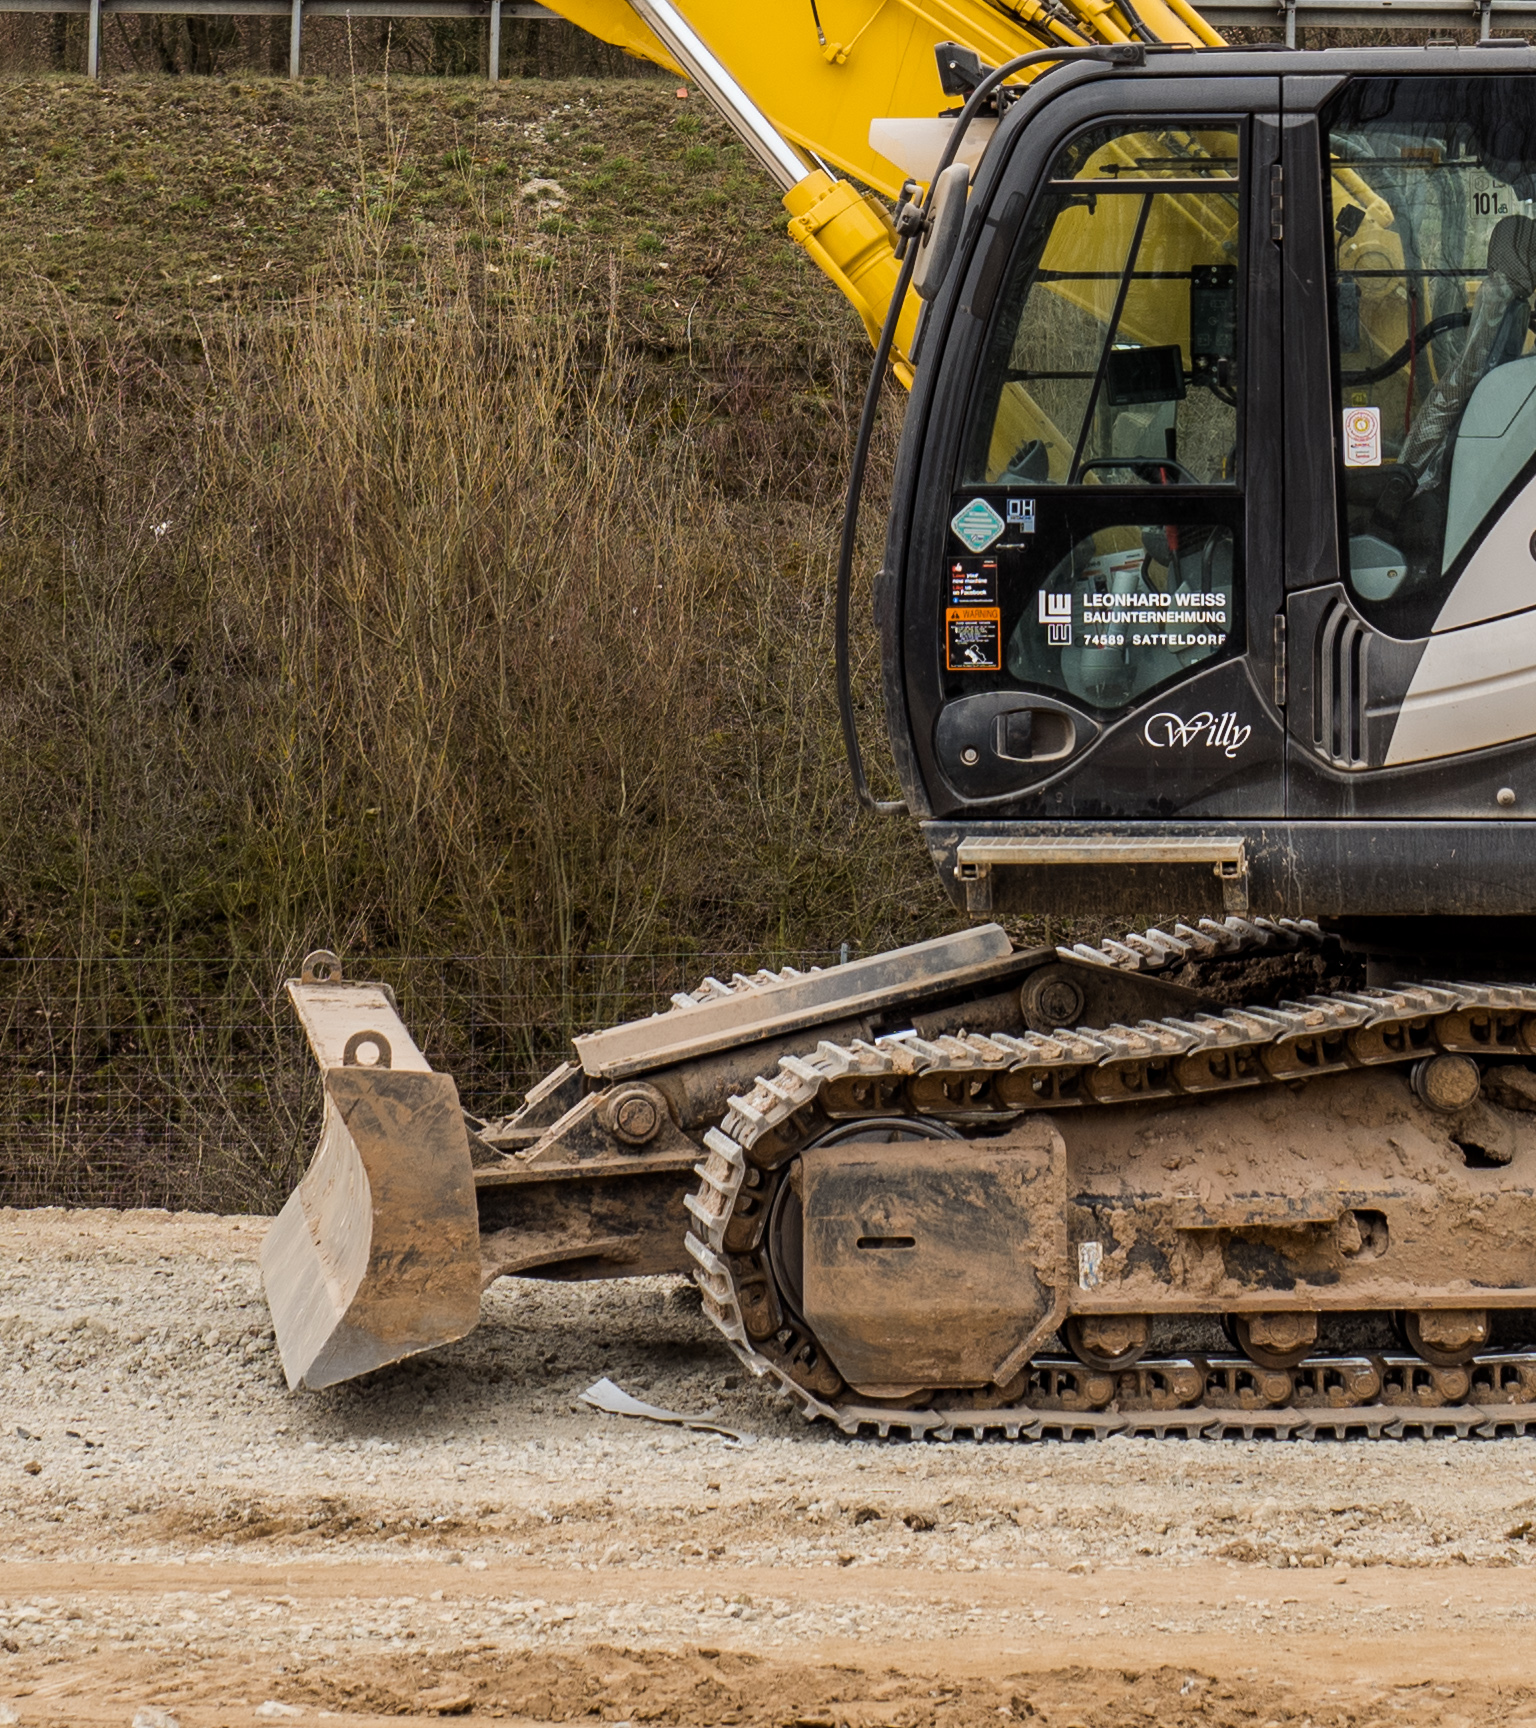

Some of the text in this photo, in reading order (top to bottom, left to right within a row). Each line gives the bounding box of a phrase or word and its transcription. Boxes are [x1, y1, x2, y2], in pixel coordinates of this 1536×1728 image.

[1472, 192, 1498, 216] 101
[1083, 592, 1227, 607] LEONHARD WEISS
[963, 609, 999, 619] WARNING
[1083, 610, 1227, 624] BAUUNTERNEHMUNG
[1083, 634, 1227, 646] 74589 SATTELDORF
[1144, 711, 1252, 759] Willy
